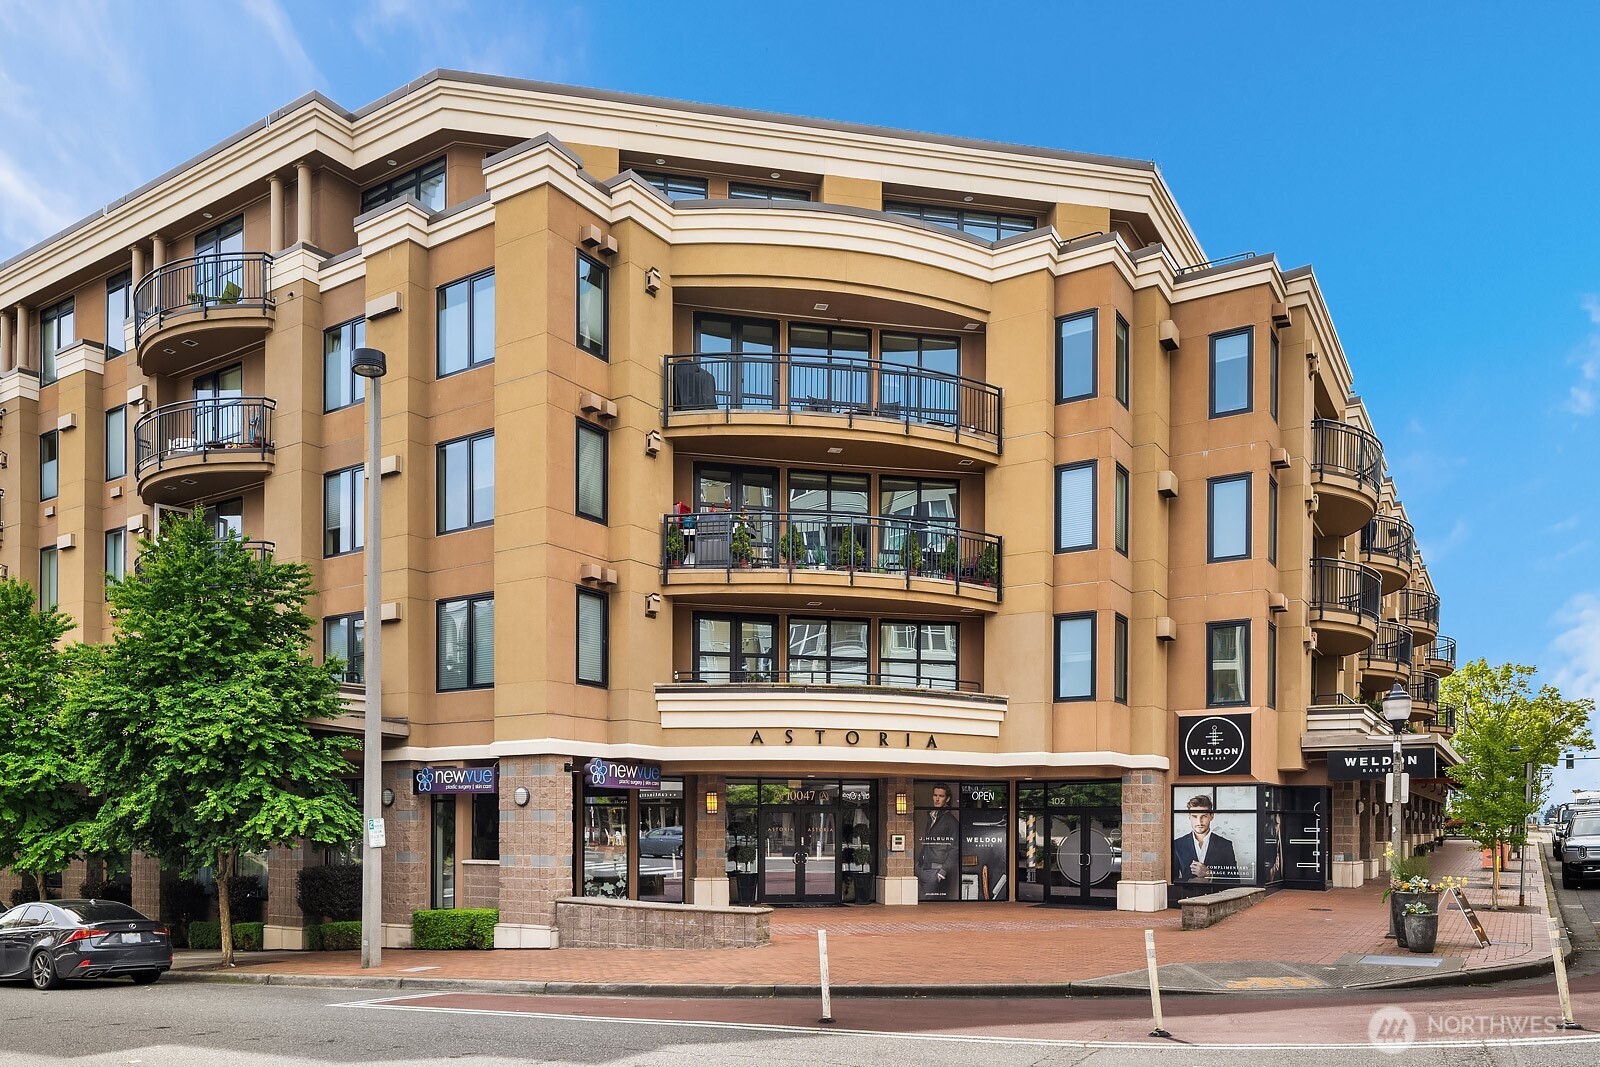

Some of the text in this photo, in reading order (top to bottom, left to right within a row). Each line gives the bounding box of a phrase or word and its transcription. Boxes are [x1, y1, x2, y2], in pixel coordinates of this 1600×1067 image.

[750, 729, 938, 749] ASTORIA
[1190, 747, 1239, 756] WELDON
[435, 769, 493, 784] newvue
[609, 763, 660, 780] newvue
[787, 791, 816, 801] 10047
[971, 791, 995, 801] OPEN
[1051, 797, 1066, 805] 102
